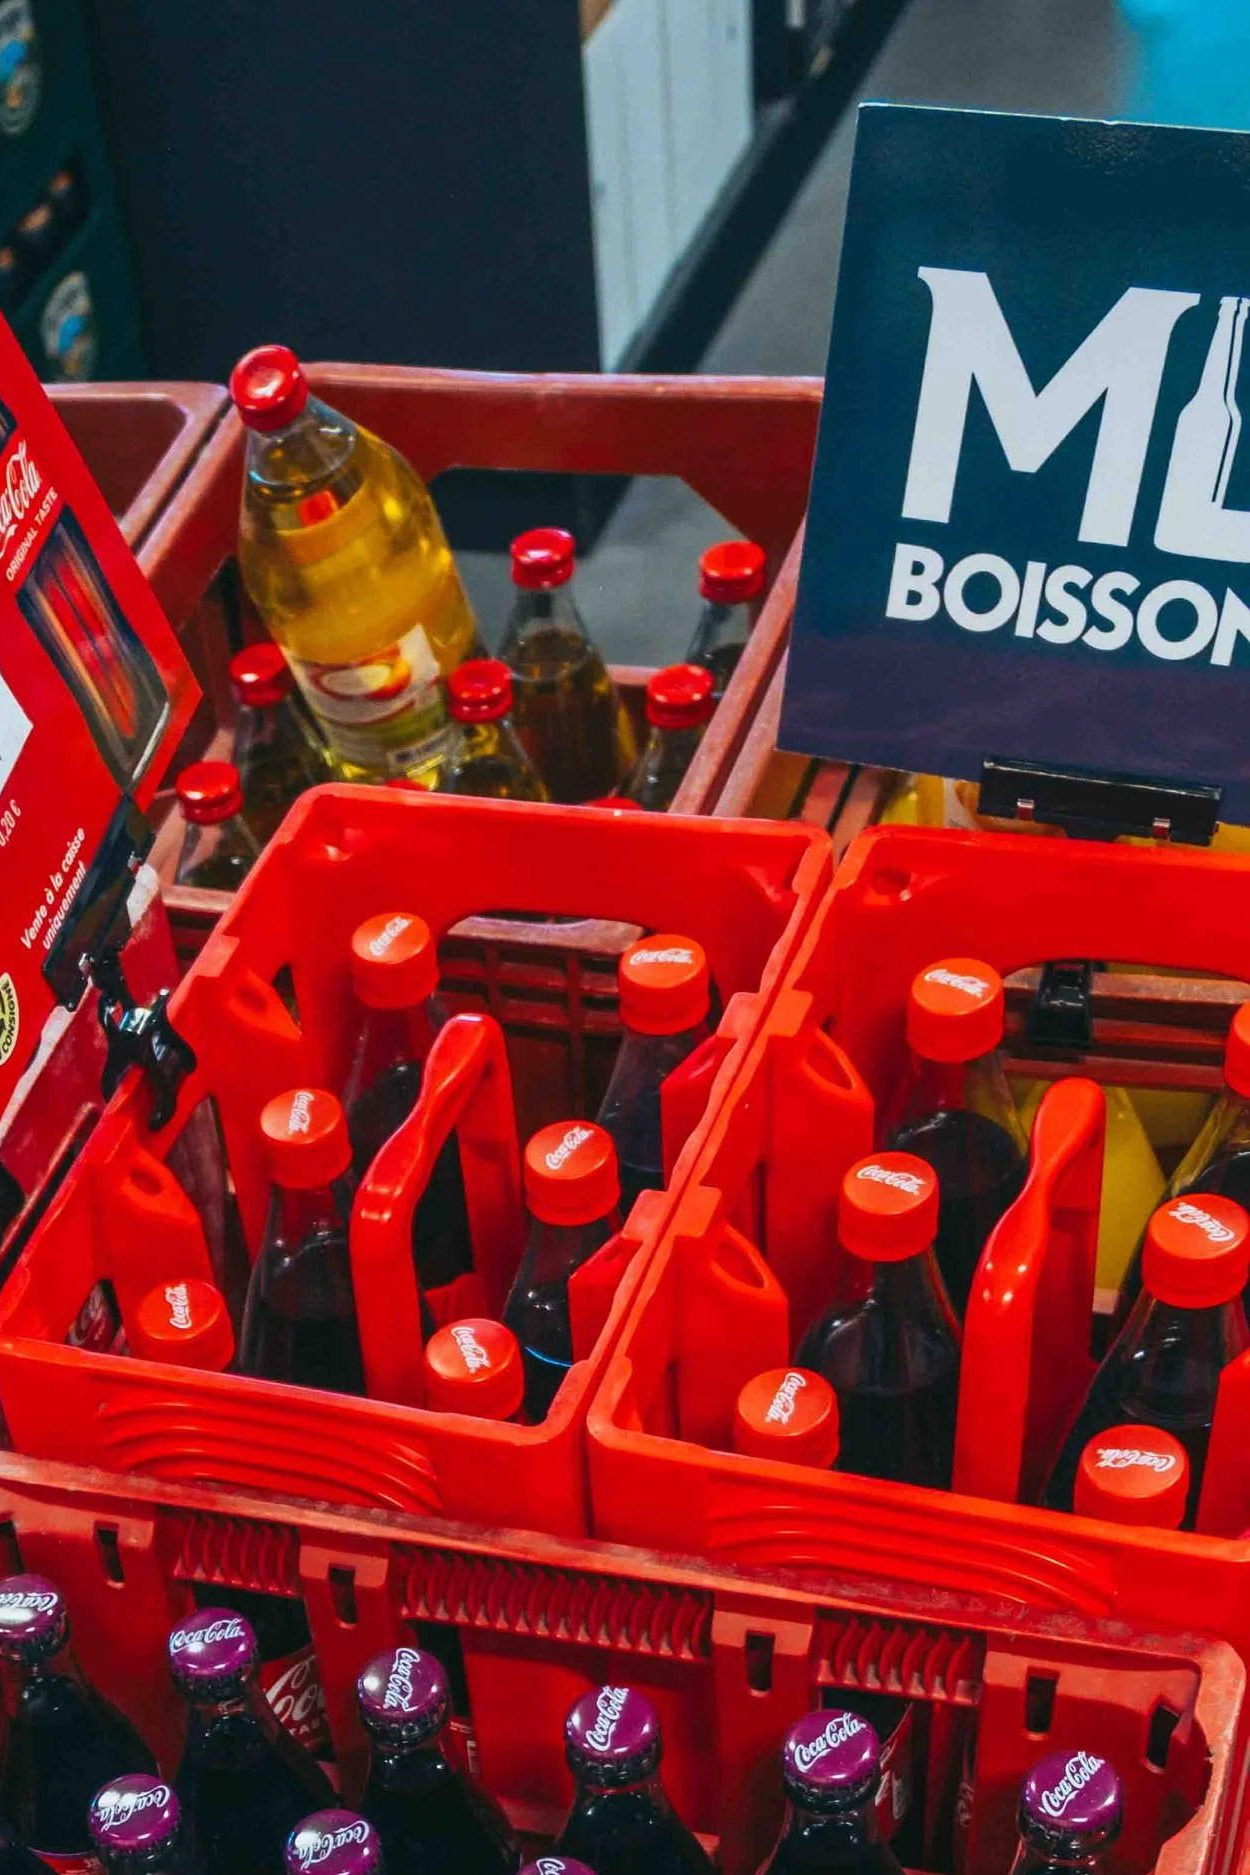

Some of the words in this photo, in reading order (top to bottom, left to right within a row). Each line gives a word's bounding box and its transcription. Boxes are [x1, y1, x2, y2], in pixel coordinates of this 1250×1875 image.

[5, 527, 39, 581] ORIGINAL
[34, 486, 58, 526] TASTE
[62, 828, 85, 868] caisse
[42, 861, 87, 949] uniquement
[46, 886, 55, 905] à
[50, 870, 63, 893] la
[21, 908, 48, 949] Vente
[169, 1616, 246, 1653] Coca-Cola
[383, 1646, 422, 1713] Coca-Cola
[584, 1684, 630, 1752] Coca-Cola
[793, 1711, 866, 1774] Coca-Cola
[1038, 1750, 1106, 1819] Coca-Cola
